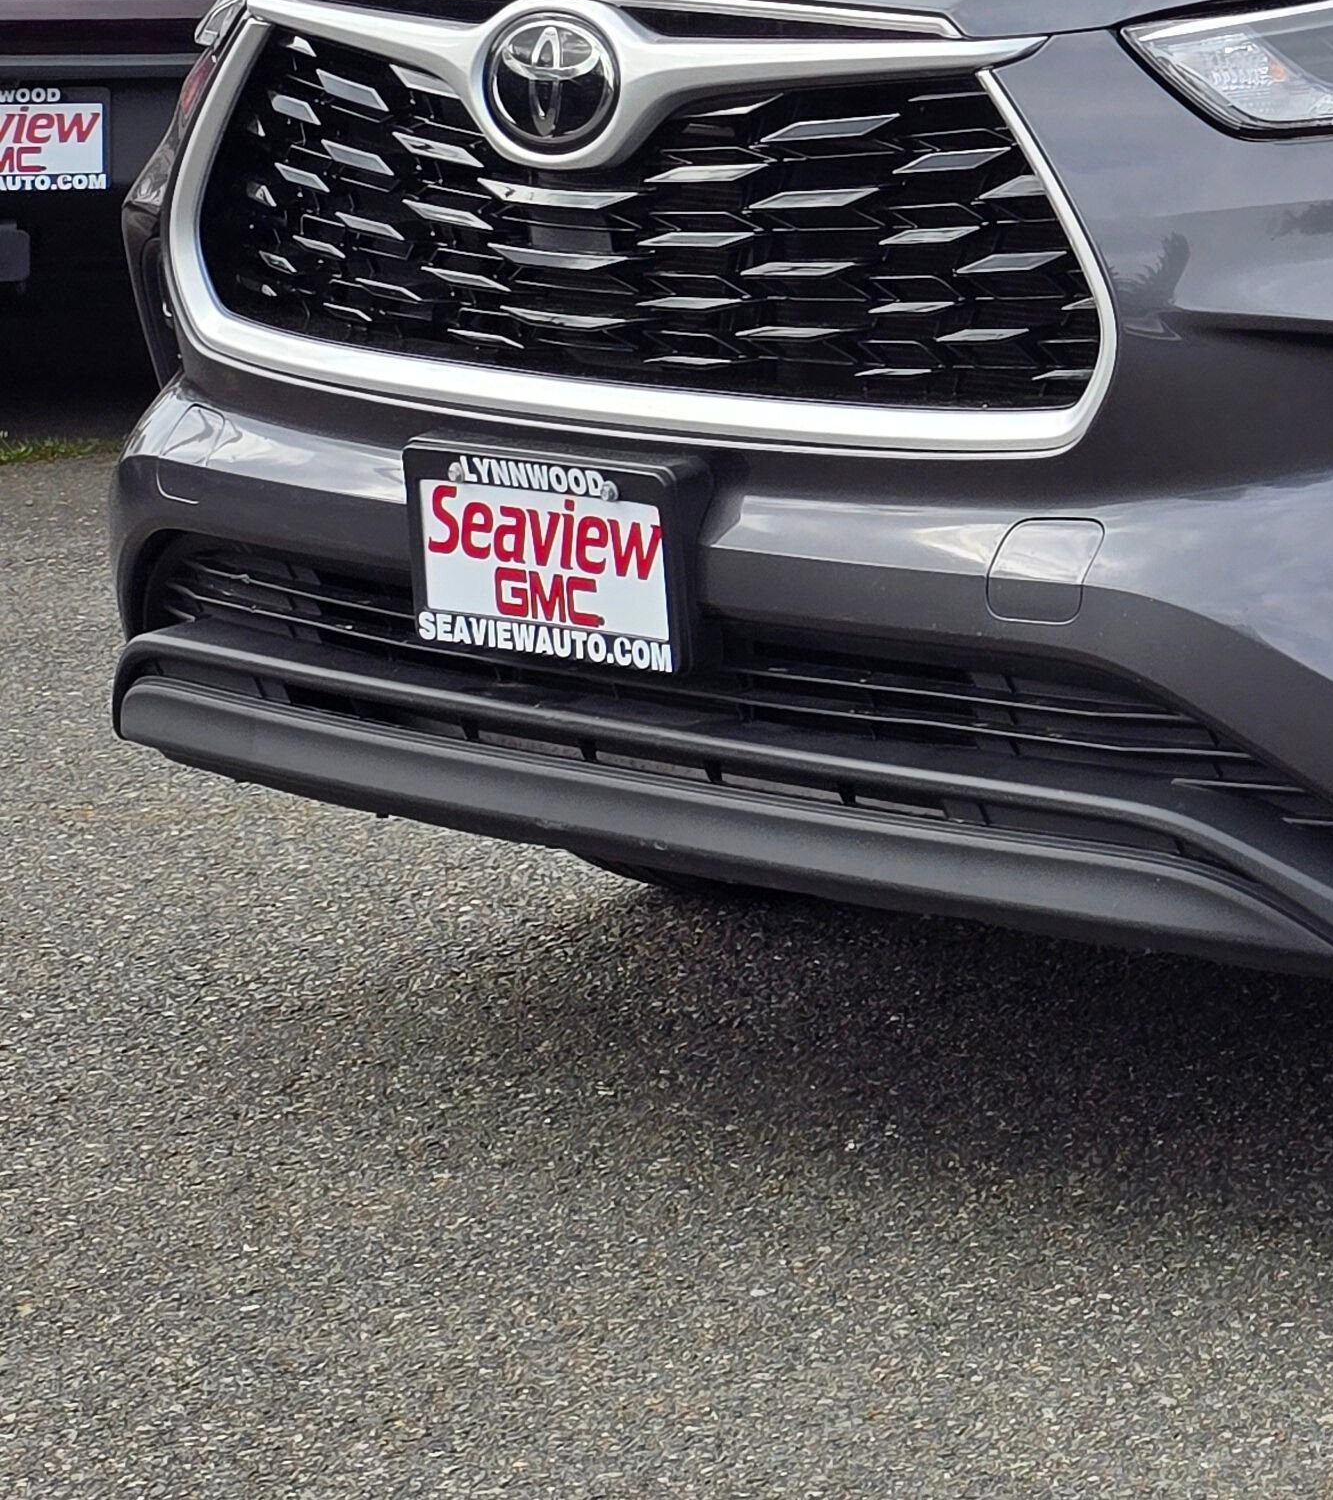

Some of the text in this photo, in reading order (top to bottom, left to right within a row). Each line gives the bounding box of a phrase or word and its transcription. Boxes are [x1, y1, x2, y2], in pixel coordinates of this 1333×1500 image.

[459, 455, 605, 497] LYNNWOOD
[428, 484, 664, 580] Seaview
[494, 566, 605, 628] GMC
[418, 611, 673, 673] SEAVIEWAUTO.COM
